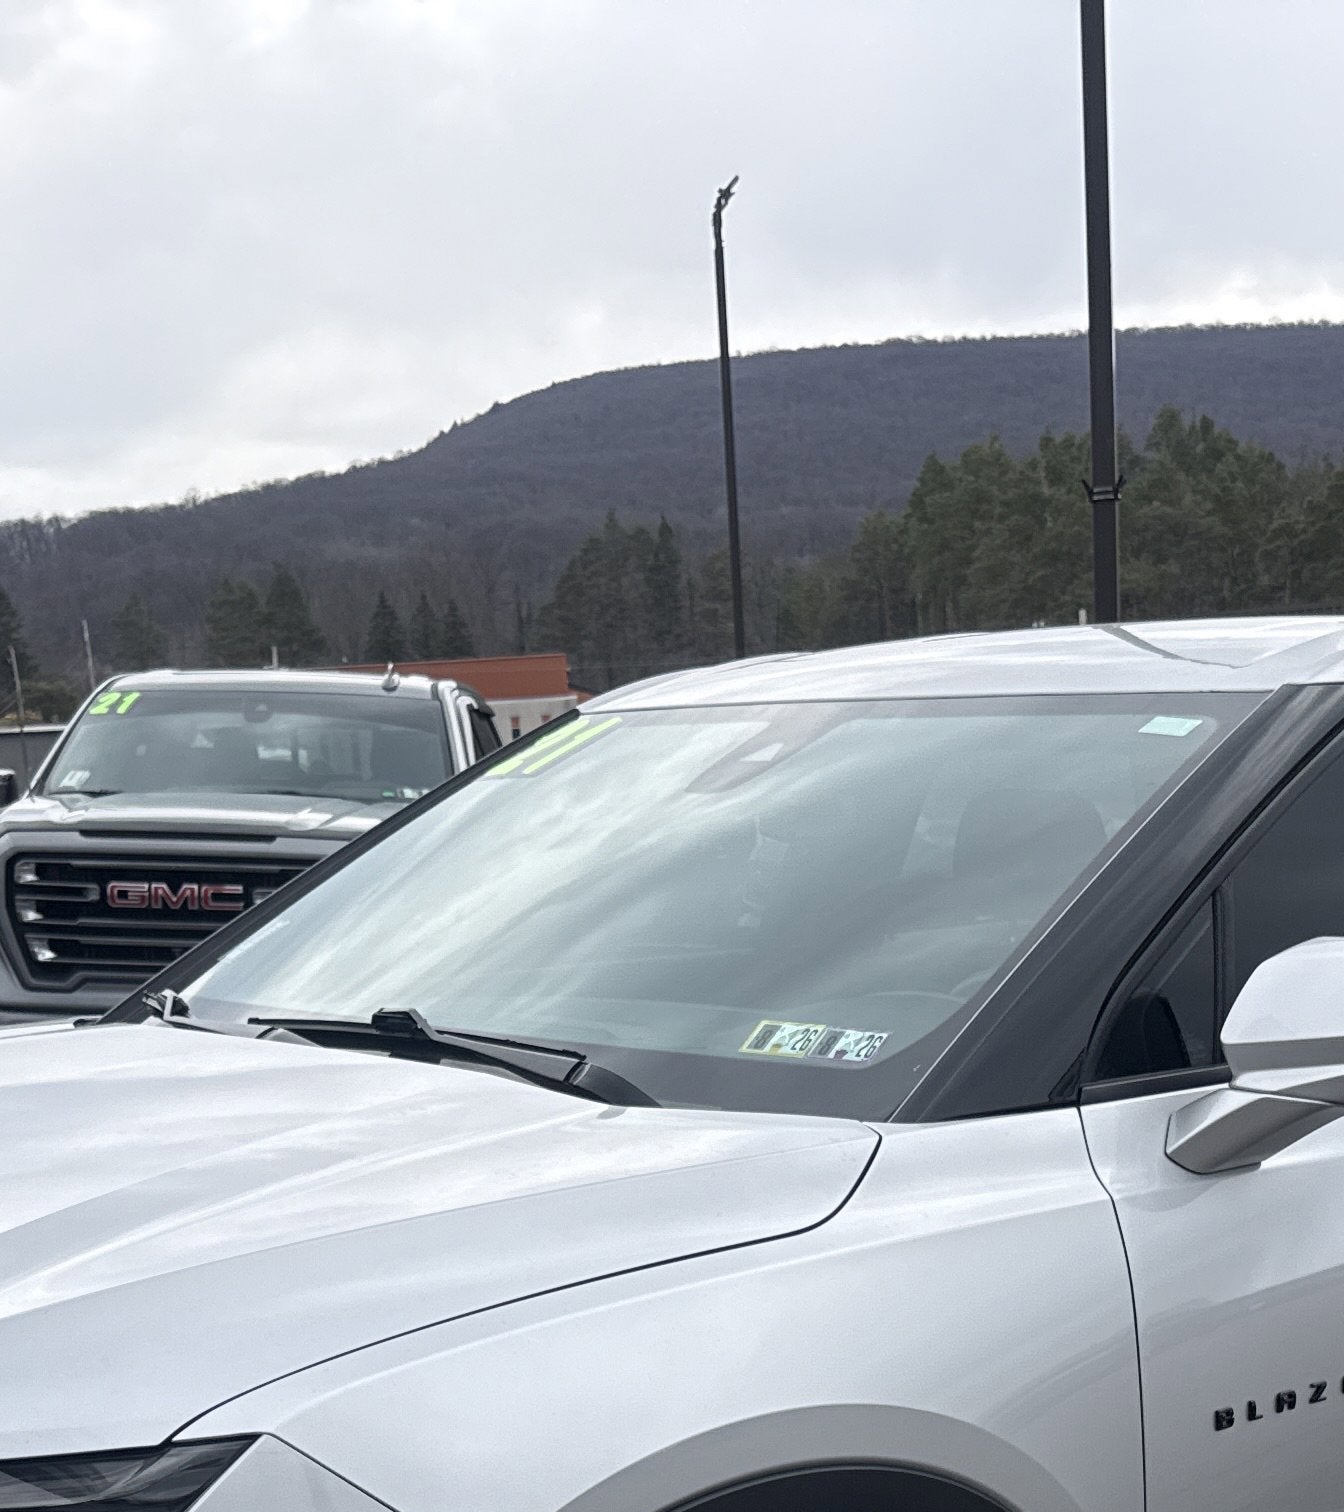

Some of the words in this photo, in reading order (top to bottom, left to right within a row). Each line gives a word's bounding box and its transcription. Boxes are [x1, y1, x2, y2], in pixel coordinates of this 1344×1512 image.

[89, 692, 141, 714] 21
[107, 881, 244, 911] GMC
[791, 1028, 819, 1052] 26
[855, 1034, 884, 1059] 26
